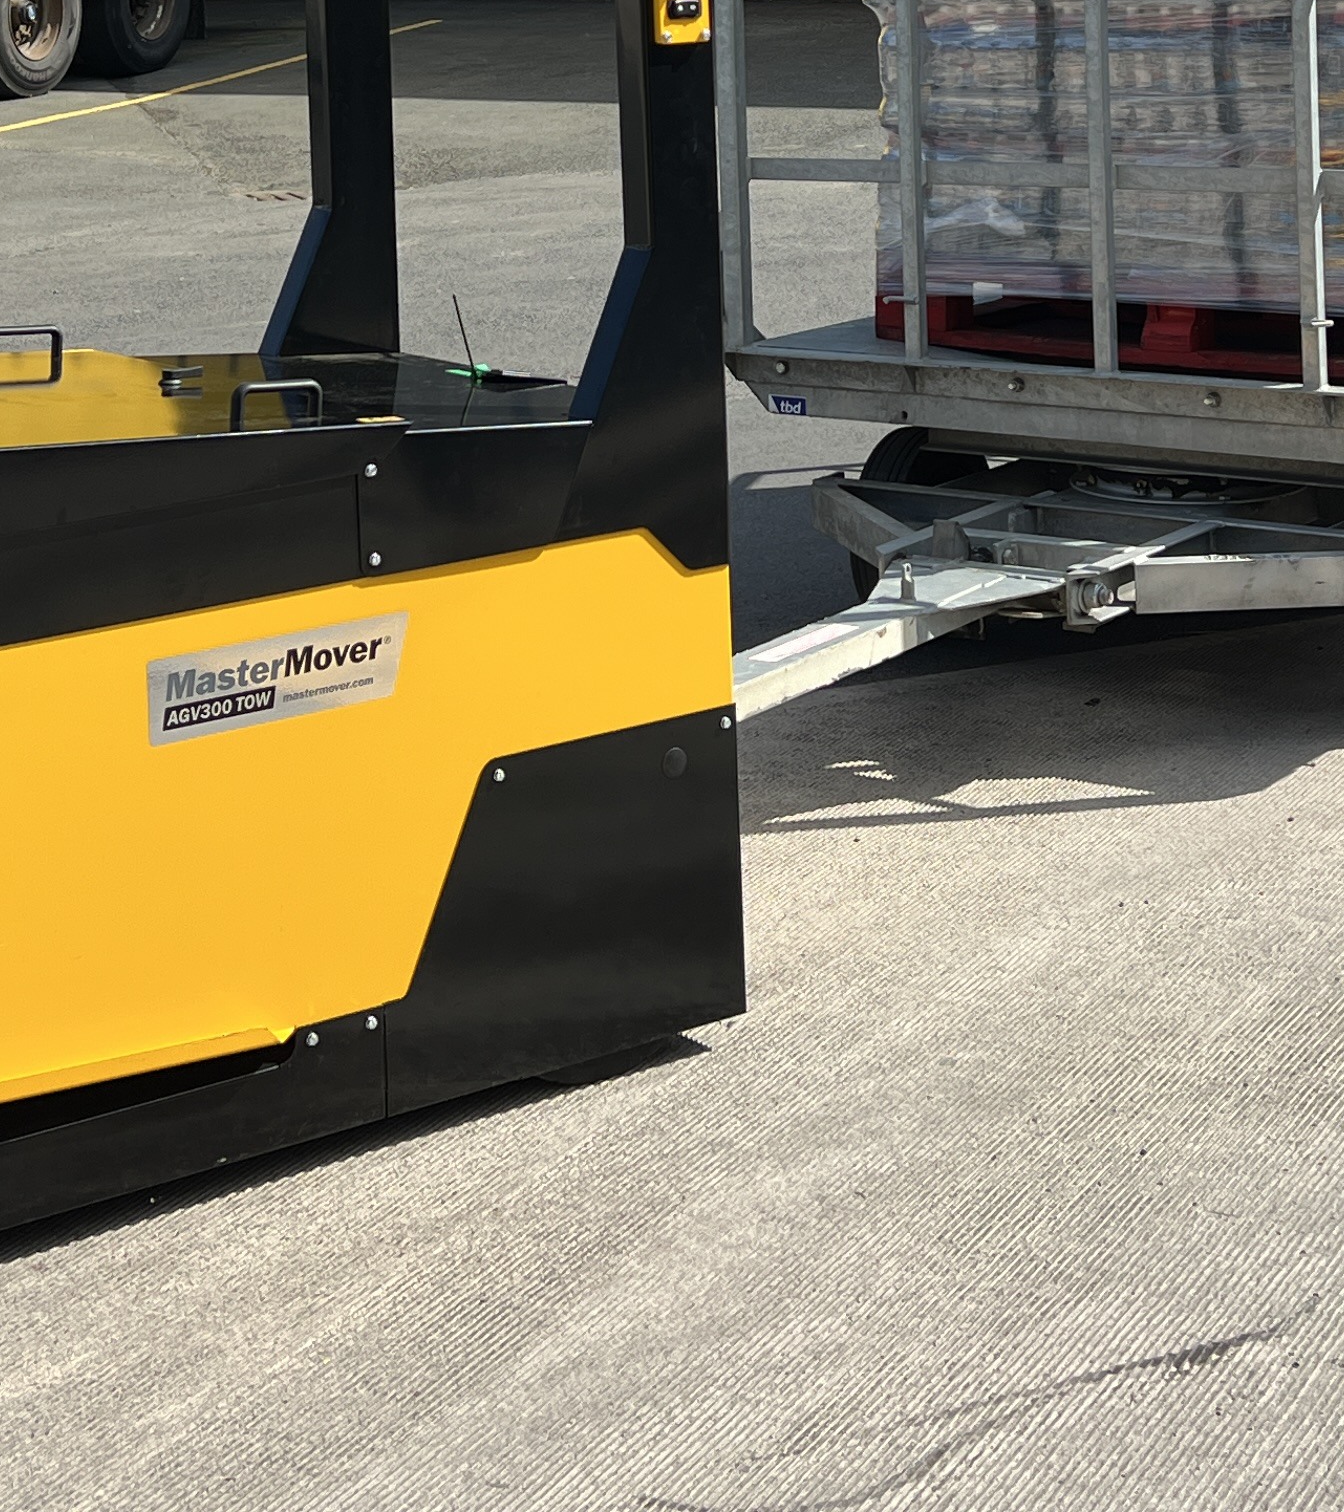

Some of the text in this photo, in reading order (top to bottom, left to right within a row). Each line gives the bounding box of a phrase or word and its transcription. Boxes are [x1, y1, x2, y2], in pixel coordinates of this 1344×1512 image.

[780, 400, 801, 414] tbd
[282, 676, 374, 703] mastermover.com
[166, 691, 273, 727] AGV300 TOW
